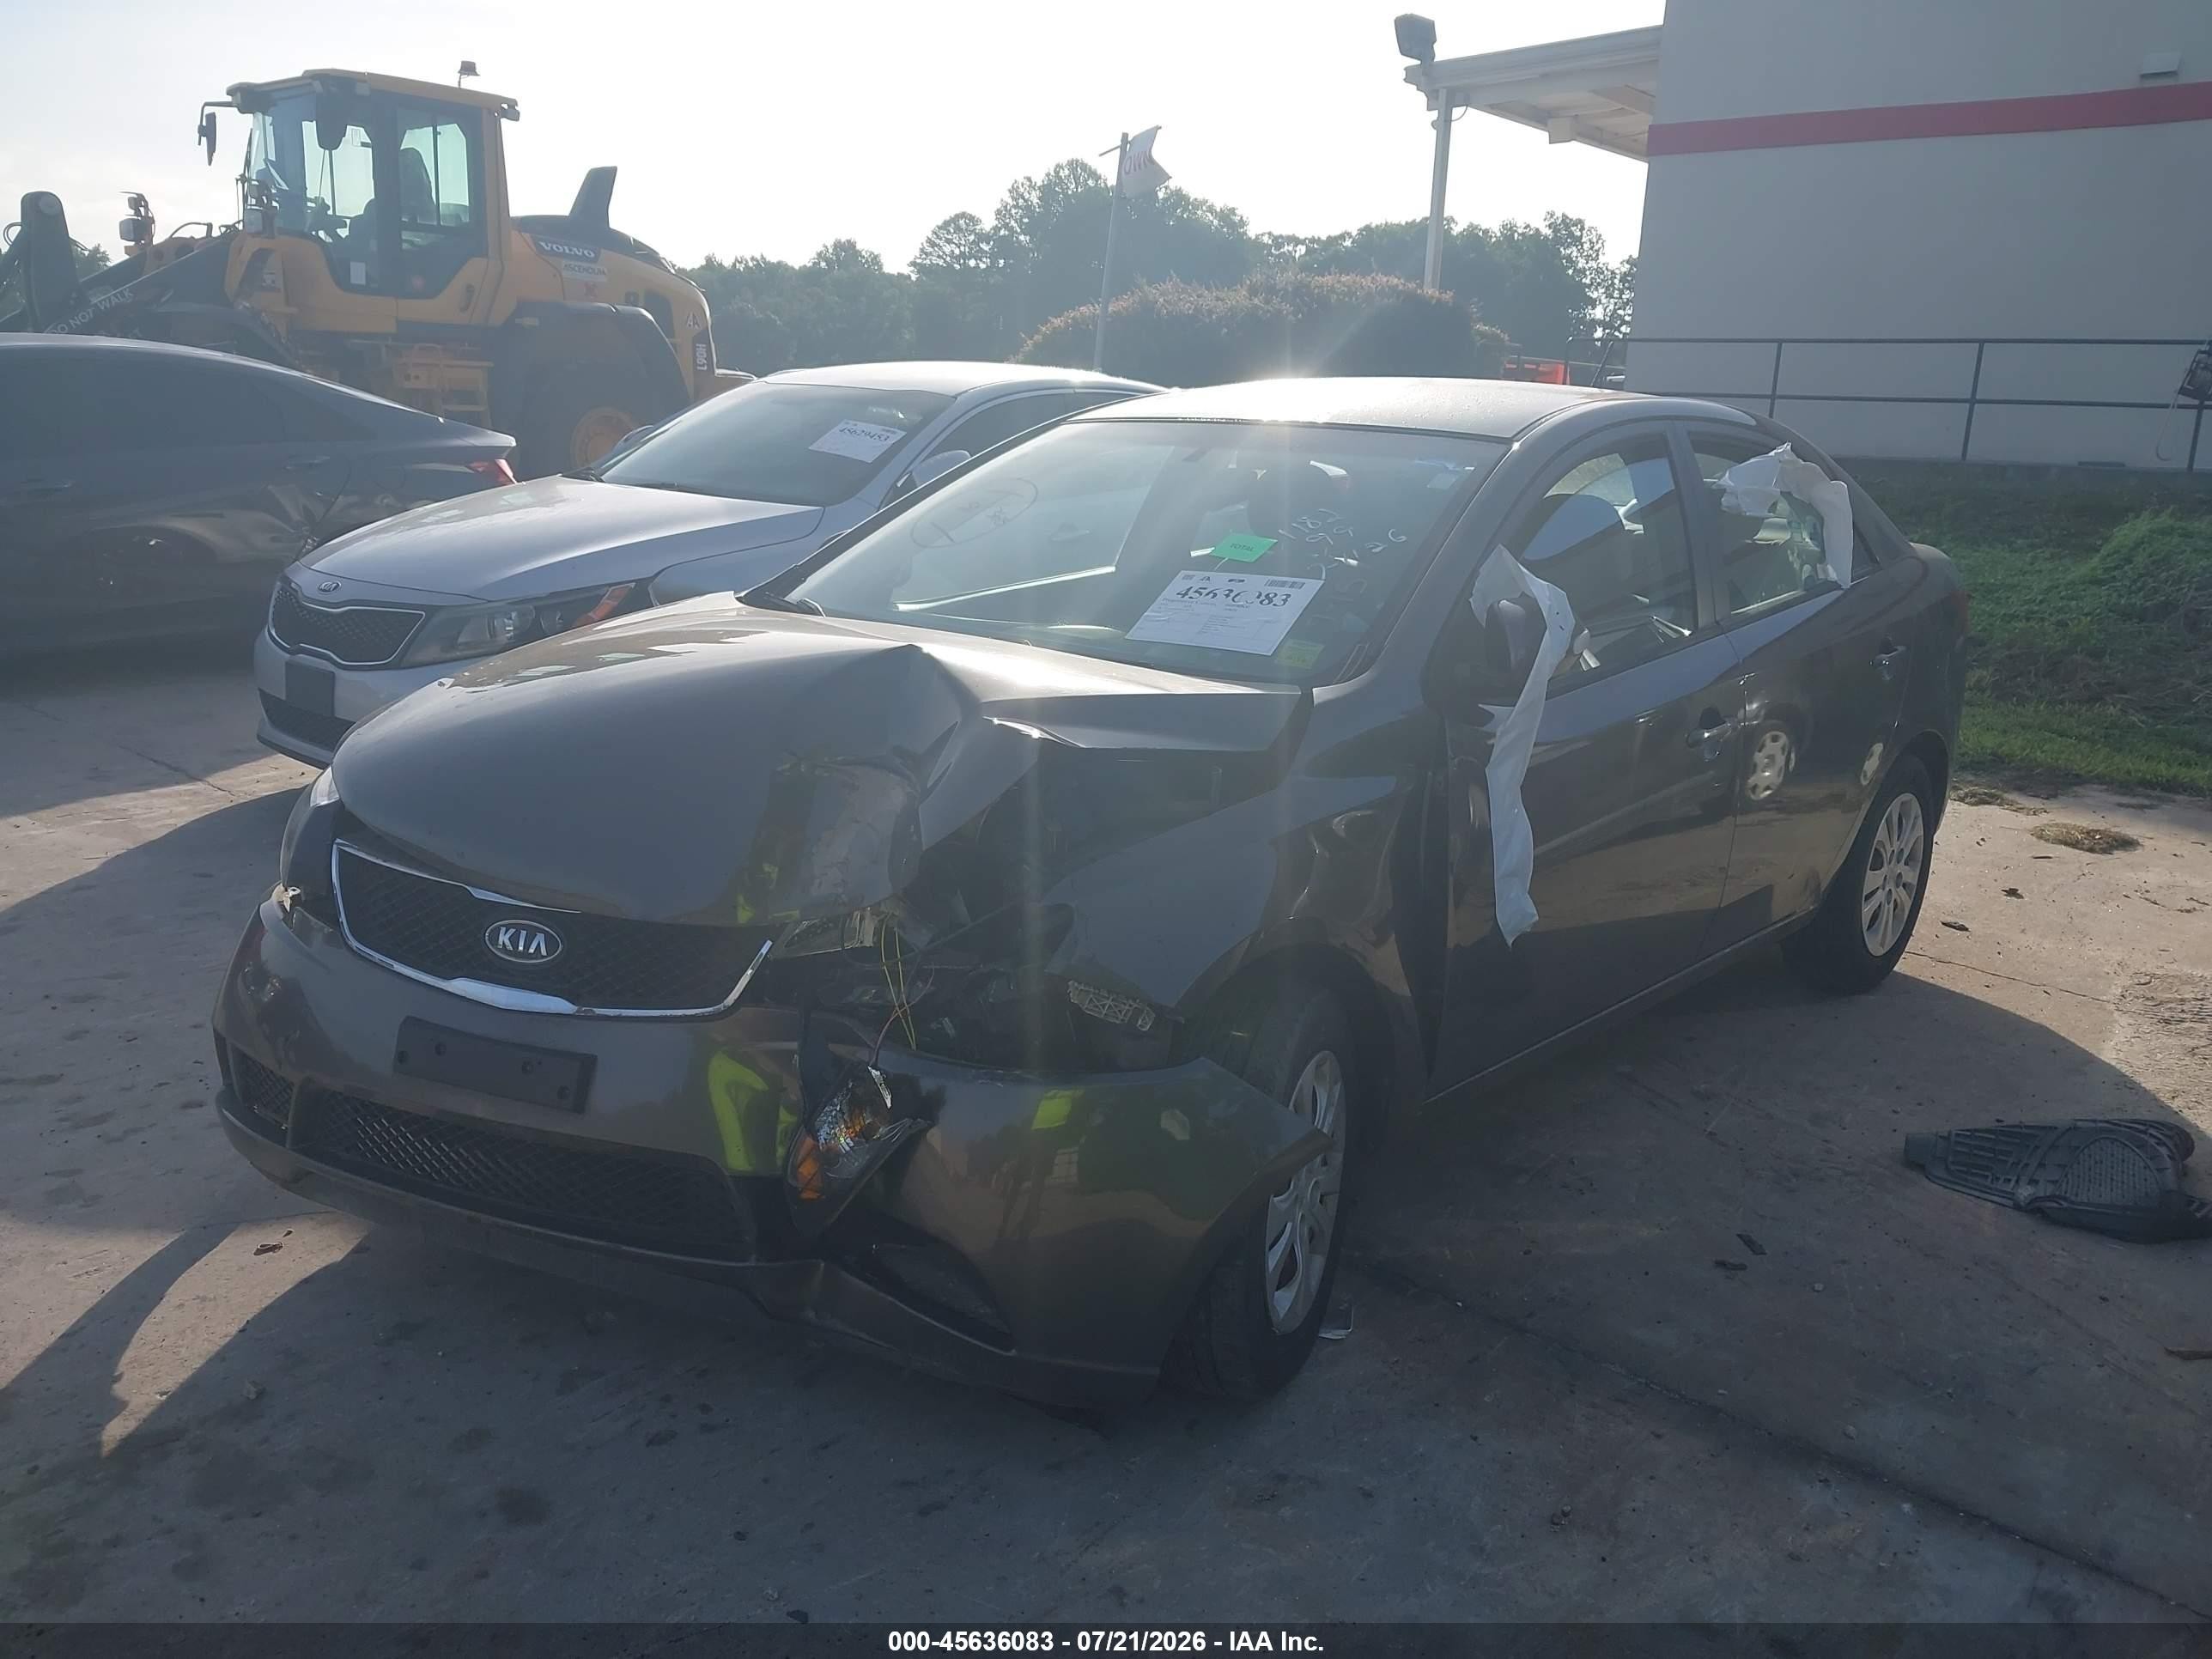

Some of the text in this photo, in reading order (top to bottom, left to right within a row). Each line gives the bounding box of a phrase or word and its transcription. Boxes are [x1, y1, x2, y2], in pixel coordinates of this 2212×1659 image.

[538, 241, 595, 258] VOLVO
[69, 307, 96, 328] NOT
[97, 288, 134, 310] WALK
[696, 343, 708, 370] L90H
[497, 927, 548, 957] KIA
